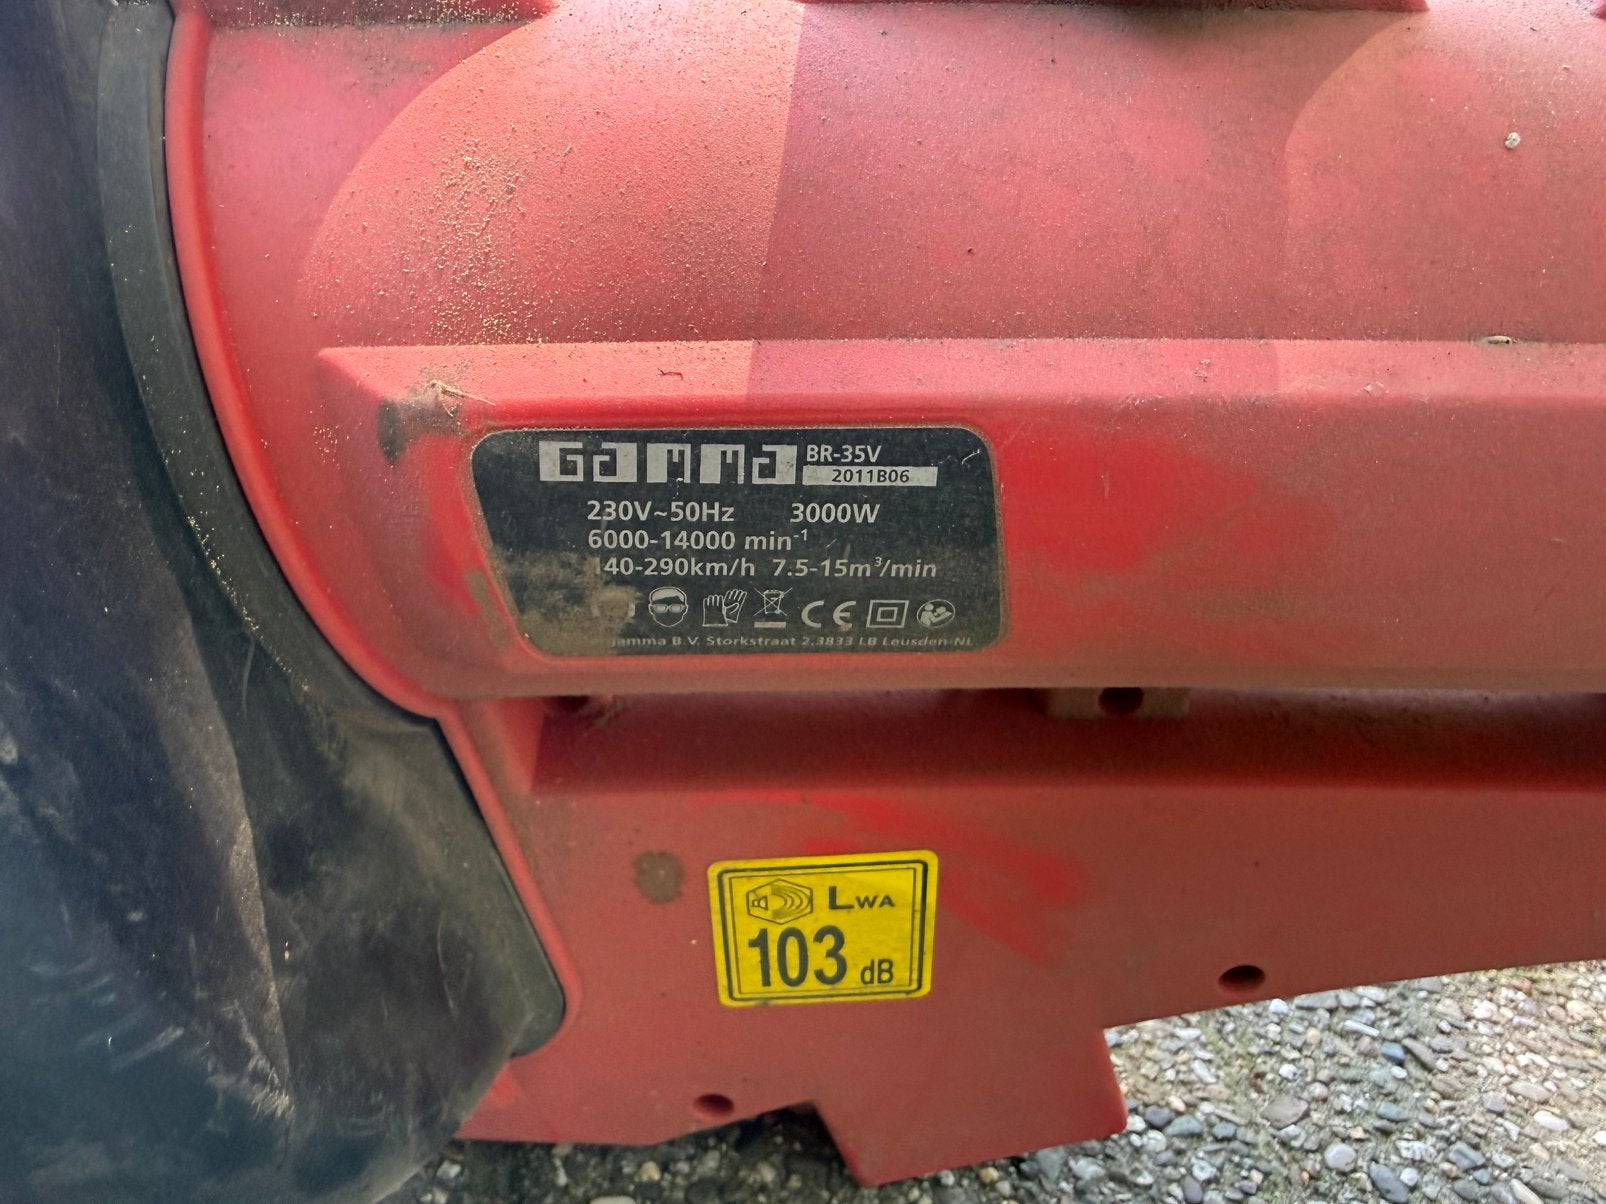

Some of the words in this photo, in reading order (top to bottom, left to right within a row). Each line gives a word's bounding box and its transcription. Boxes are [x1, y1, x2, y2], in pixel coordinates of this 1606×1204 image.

[806, 444, 882, 463] BR-35V
[831, 468, 911, 483] 2011B06
[586, 500, 735, 522] 230V~50Hz
[789, 502, 881, 523] 3000W
[588, 529, 736, 551] 6000-14000
[706, 635, 796, 647] Storkstraat
[748, 925, 848, 988] 103
[859, 958, 895, 986] dB
